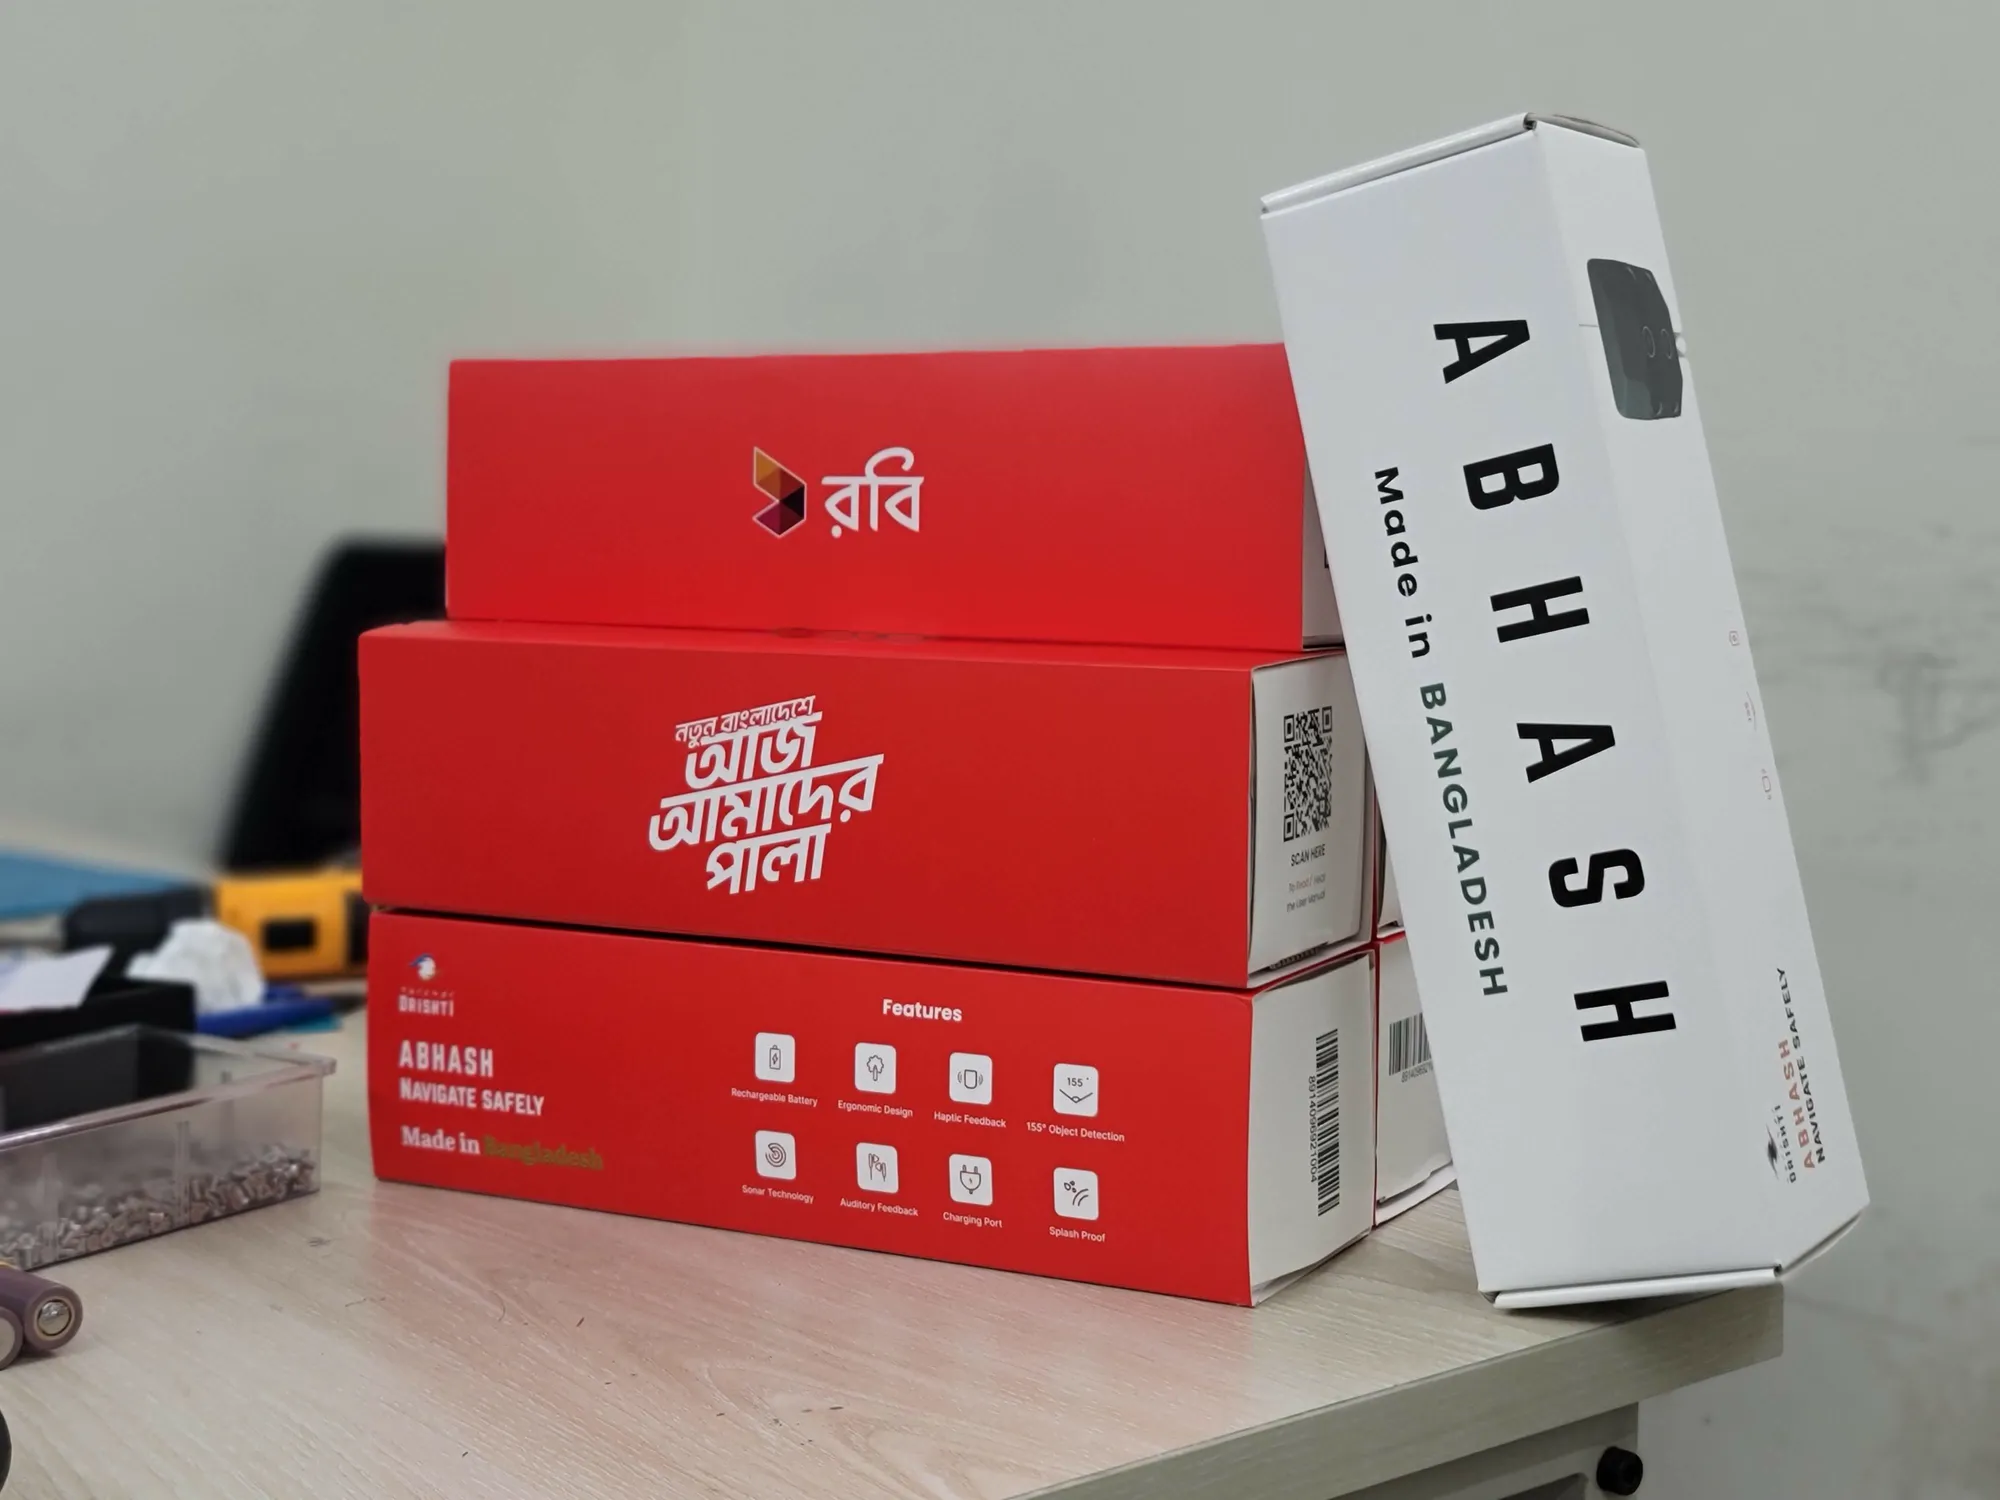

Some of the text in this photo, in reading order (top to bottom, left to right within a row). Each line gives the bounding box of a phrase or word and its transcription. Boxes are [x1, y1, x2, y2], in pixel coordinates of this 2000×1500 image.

[821, 446, 925, 539] রবি
[1433, 318, 1676, 1042] ABHASH
[675, 695, 816, 748] নতুন বাংলাদেশে
[1374, 466, 1508, 997] Made in BANGLADESH
[685, 711, 823, 789] আজ
[648, 753, 885, 851] আমাদের
[706, 823, 832, 894] পালা
[1291, 843, 1325, 867] SCAN HERE
[882, 998, 963, 1022] Features
[399, 1039, 494, 1078] ABHASH
[1776, 967, 1826, 1164] NAVIGATE SAFELY
[399, 1076, 545, 1117] NAVIGATE SAFELY
[731, 1087, 818, 1107] Rechargeable Battery
[837, 1099, 914, 1118] Ergonomic Design
[1778, 1039, 1816, 1169] ABHASH
[933, 1110, 1007, 1128] Haptic Feedback
[1026, 1121, 1125, 1142] 155° Object Detection
[402, 1124, 604, 1171] Made in Bangladesh
[741, 1184, 815, 1205] Sonar Technology
[839, 1197, 919, 1217] Auditory Feedback
[942, 1211, 1003, 1229] Charging Port
[1049, 1226, 1106, 1243] Splash Proof
